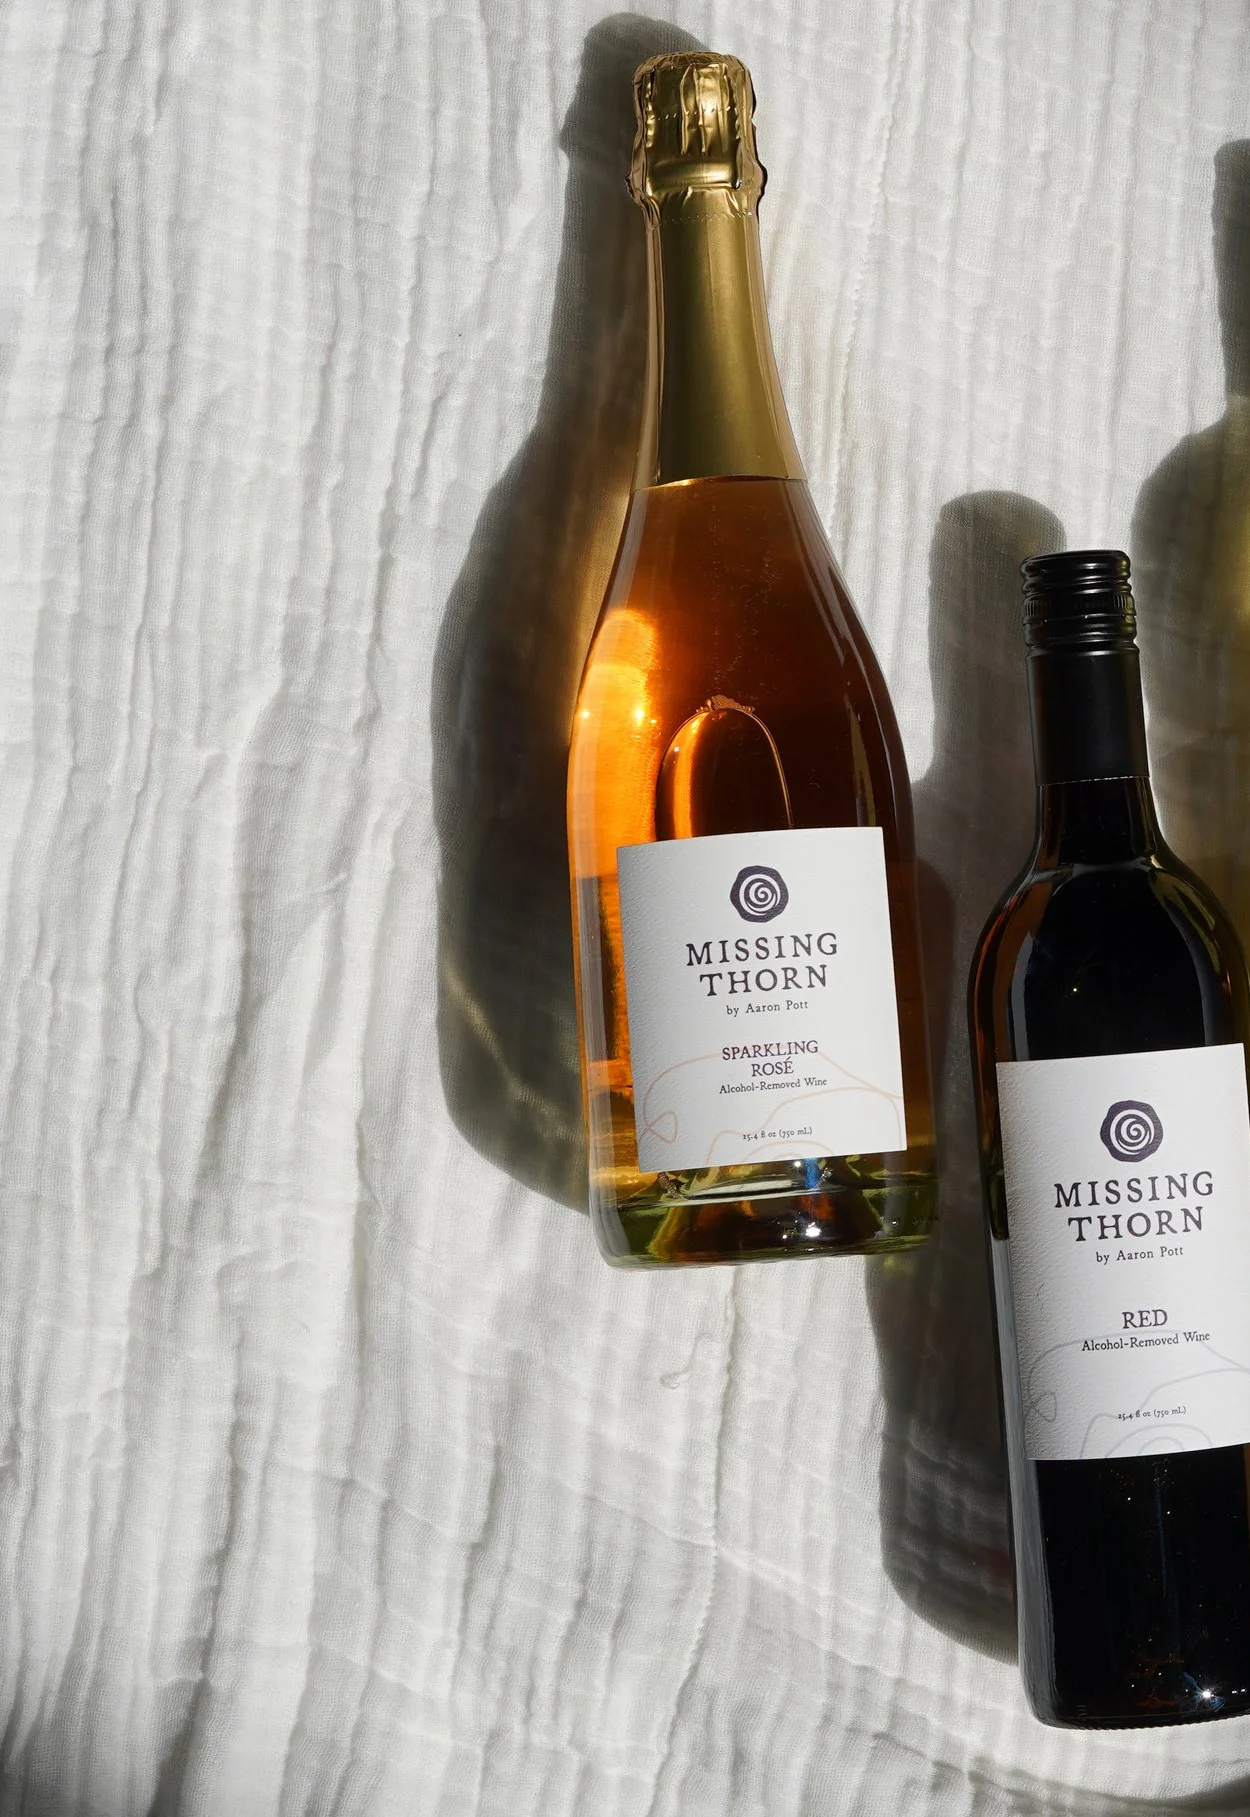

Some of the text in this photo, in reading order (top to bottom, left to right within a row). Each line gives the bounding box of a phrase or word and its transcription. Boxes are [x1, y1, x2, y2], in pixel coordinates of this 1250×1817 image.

[685, 932, 838, 967] MISSING
[699, 963, 828, 997] THORN
[725, 999, 809, 1018] by Aaron Pott
[722, 1039, 819, 1062] SPARKLING
[750, 1055, 795, 1078] ROSÉ
[719, 1076, 828, 1095] Alcohol-Removed Wine
[742, 1133, 759, 1142] 25.4
[778, 1129, 795, 1139] (750
[1053, 1170, 1214, 1209] MISSING
[1067, 1205, 1204, 1242] THORN
[1095, 1245, 1184, 1266] by Aaron Pott
[1121, 1308, 1168, 1330] RED
[1081, 1330, 1210, 1352] Alcohol-Removed Wine
[1117, 1413, 1134, 1422] 25.4
[1153, 1408, 1170, 1419] (750
